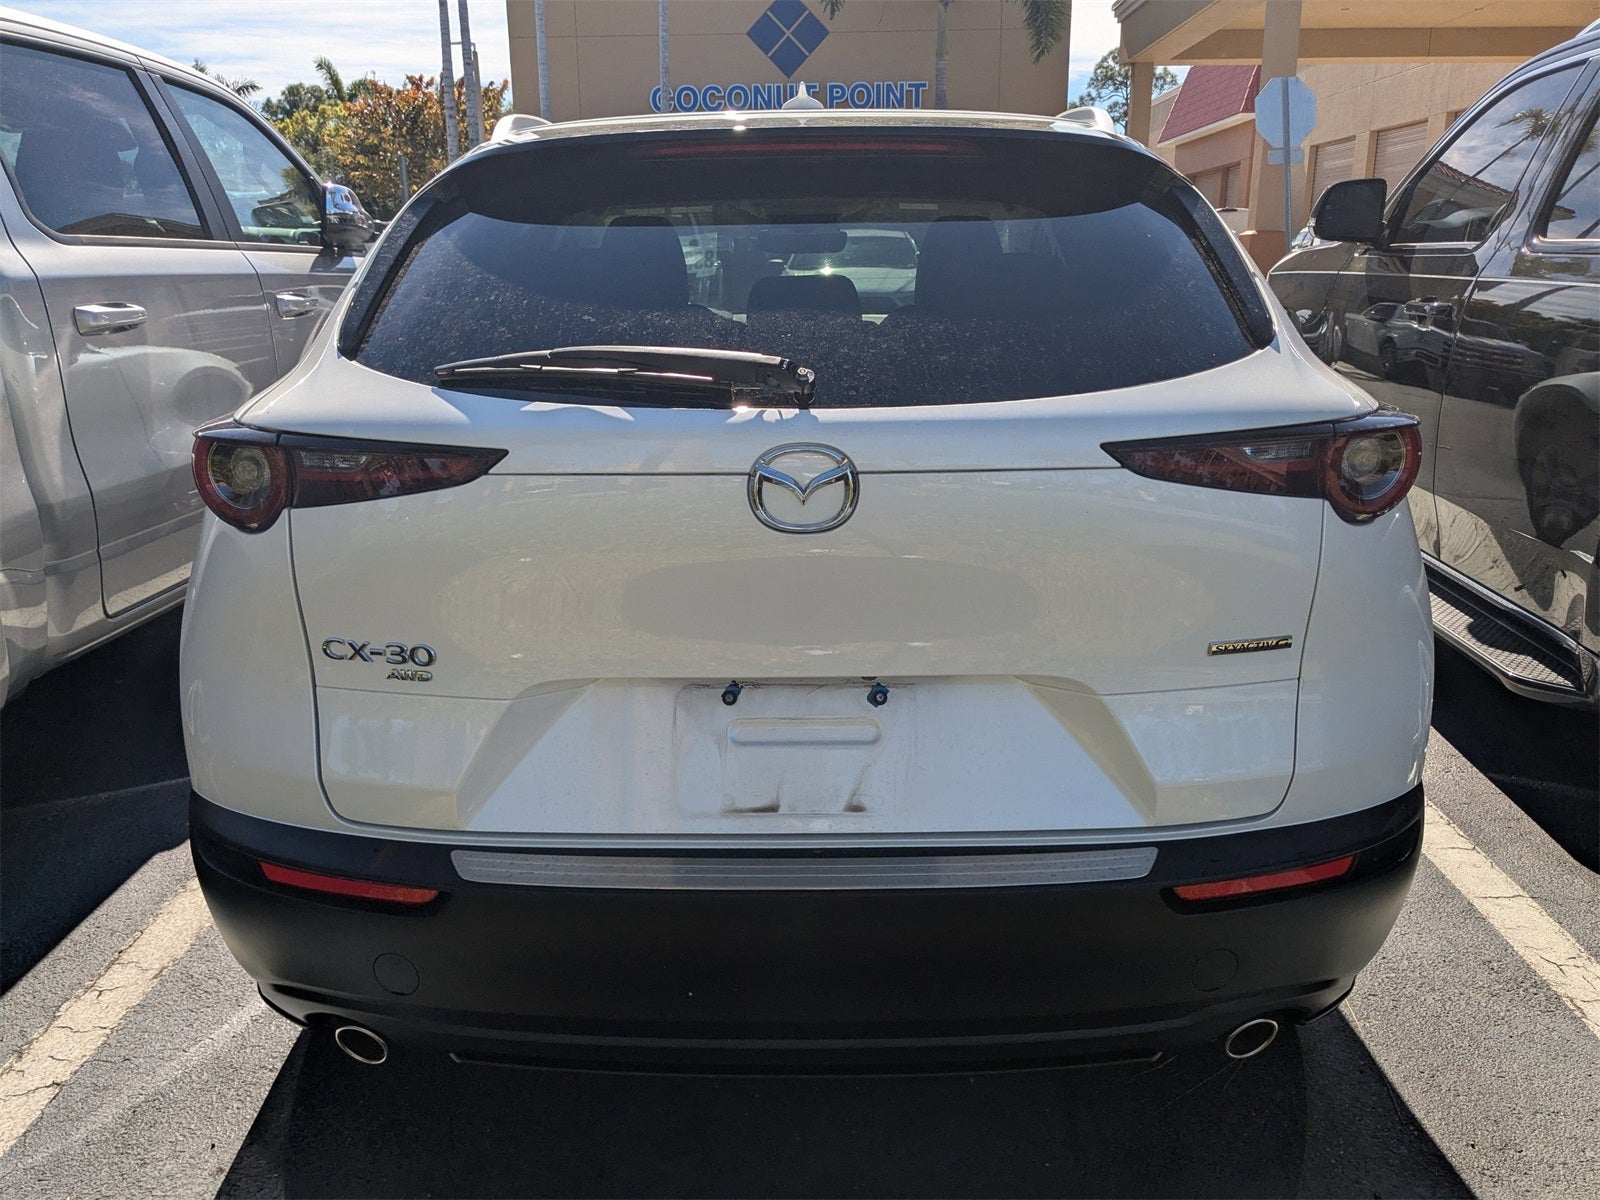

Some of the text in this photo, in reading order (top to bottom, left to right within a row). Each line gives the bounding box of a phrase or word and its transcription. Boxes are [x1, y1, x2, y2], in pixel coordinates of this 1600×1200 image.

[827, 82, 928, 109] POINT
[322, 637, 437, 667] CX-30
[386, 668, 433, 682] AWD
